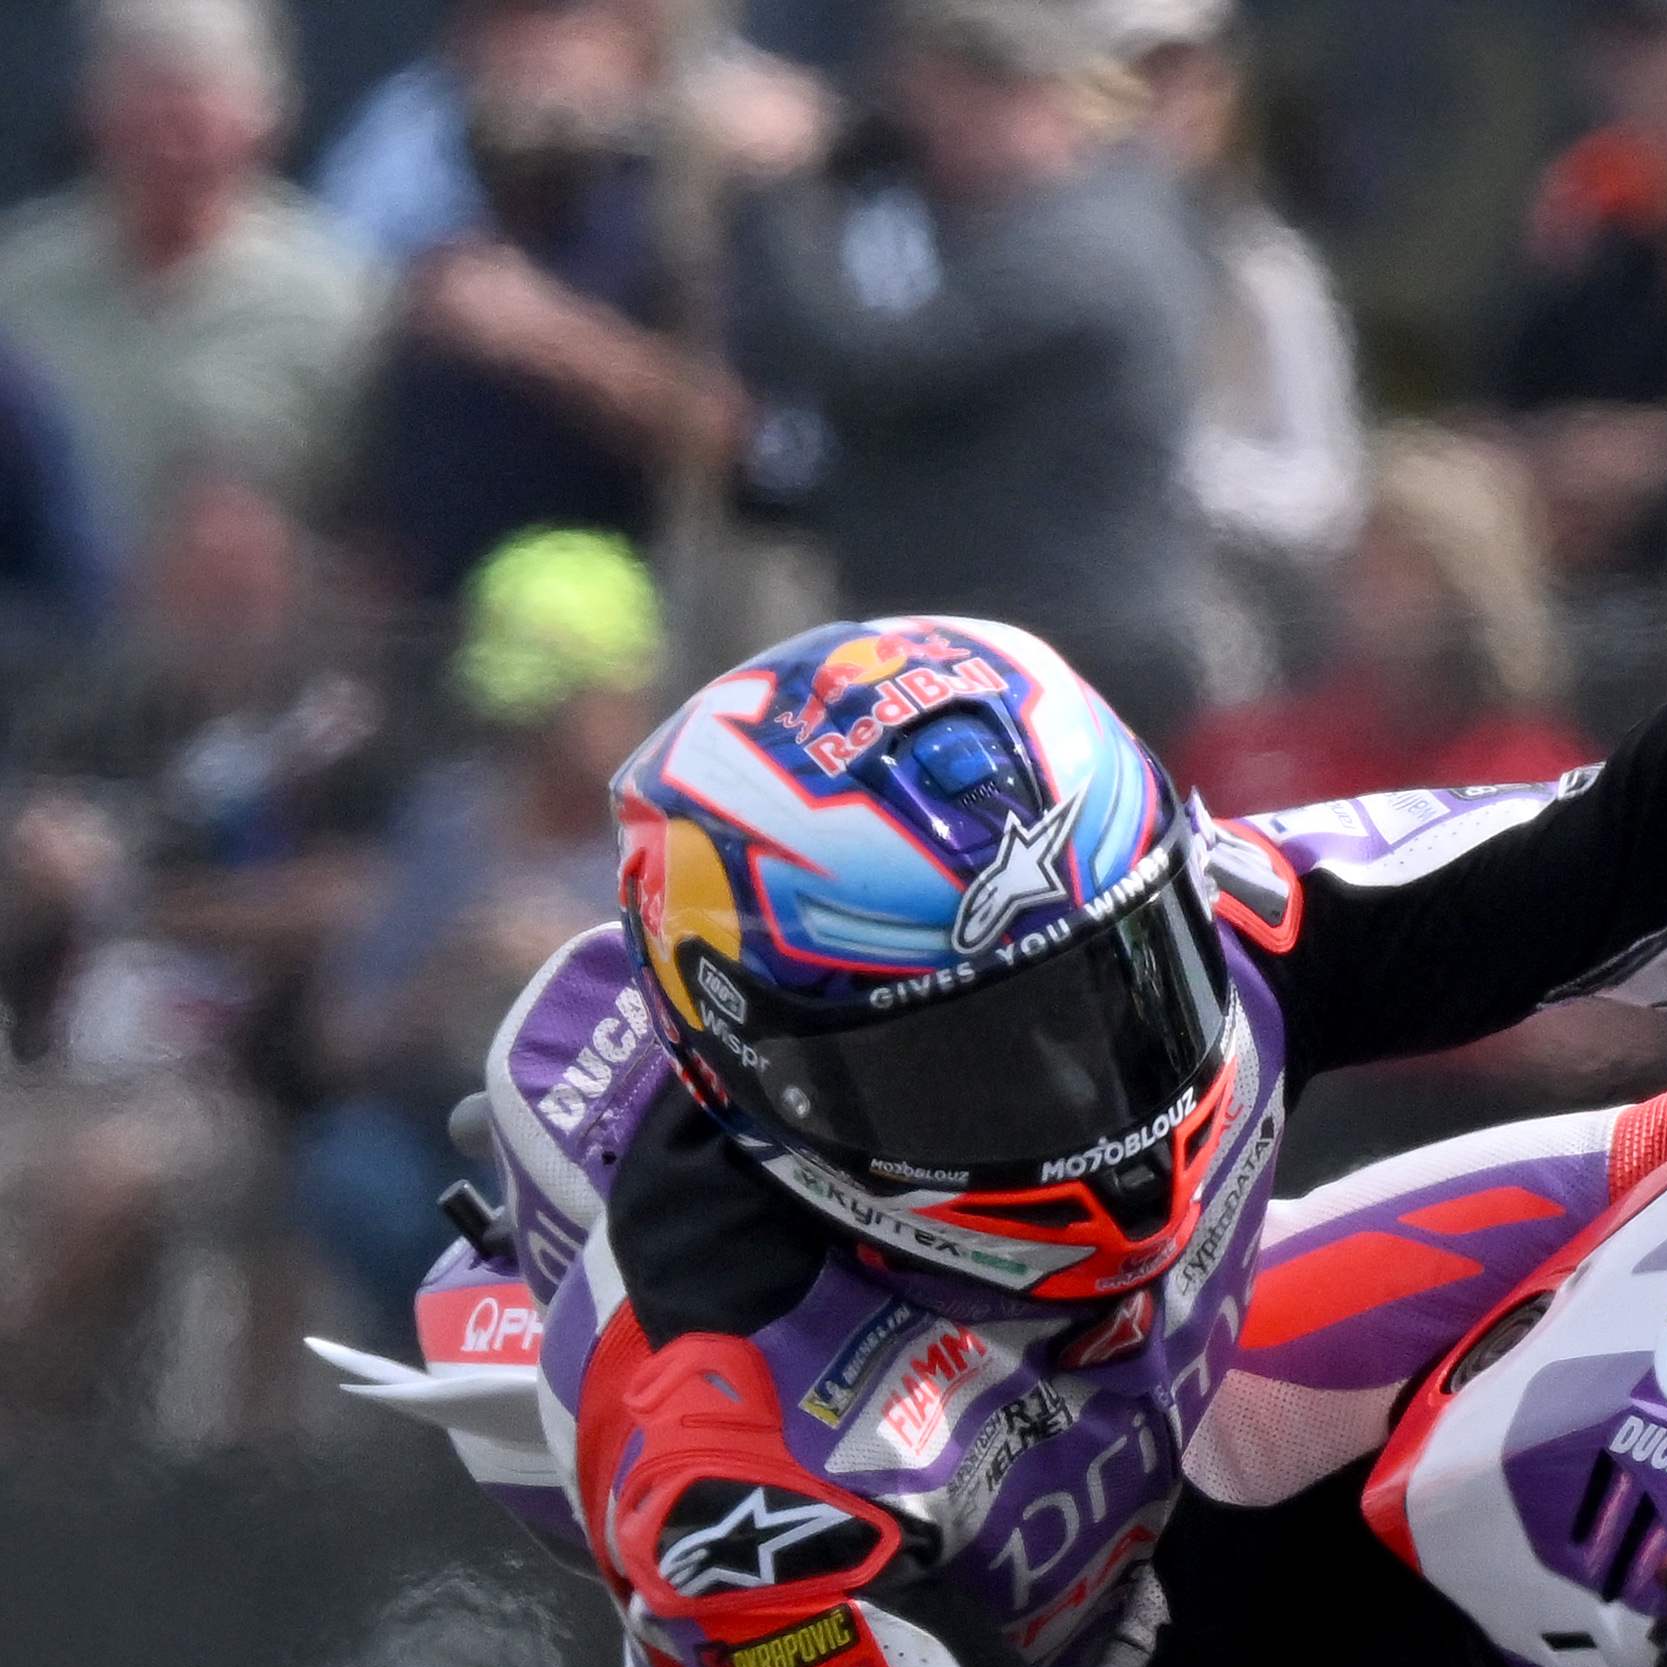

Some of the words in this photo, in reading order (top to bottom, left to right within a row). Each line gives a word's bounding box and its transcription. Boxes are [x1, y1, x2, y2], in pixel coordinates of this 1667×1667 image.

[805, 682, 914, 778] Red
[900, 658, 1008, 709] Bull
[869, 961, 976, 1010] GIVES
[995, 917, 1072, 967] YOU
[1084, 847, 1169, 921] WINGS
[869, 1156, 970, 1184] MOTOBLOUZ
[1041, 1086, 1197, 1182] MOTOBLOUZ
[880, 1325, 989, 1450] FIAMM
